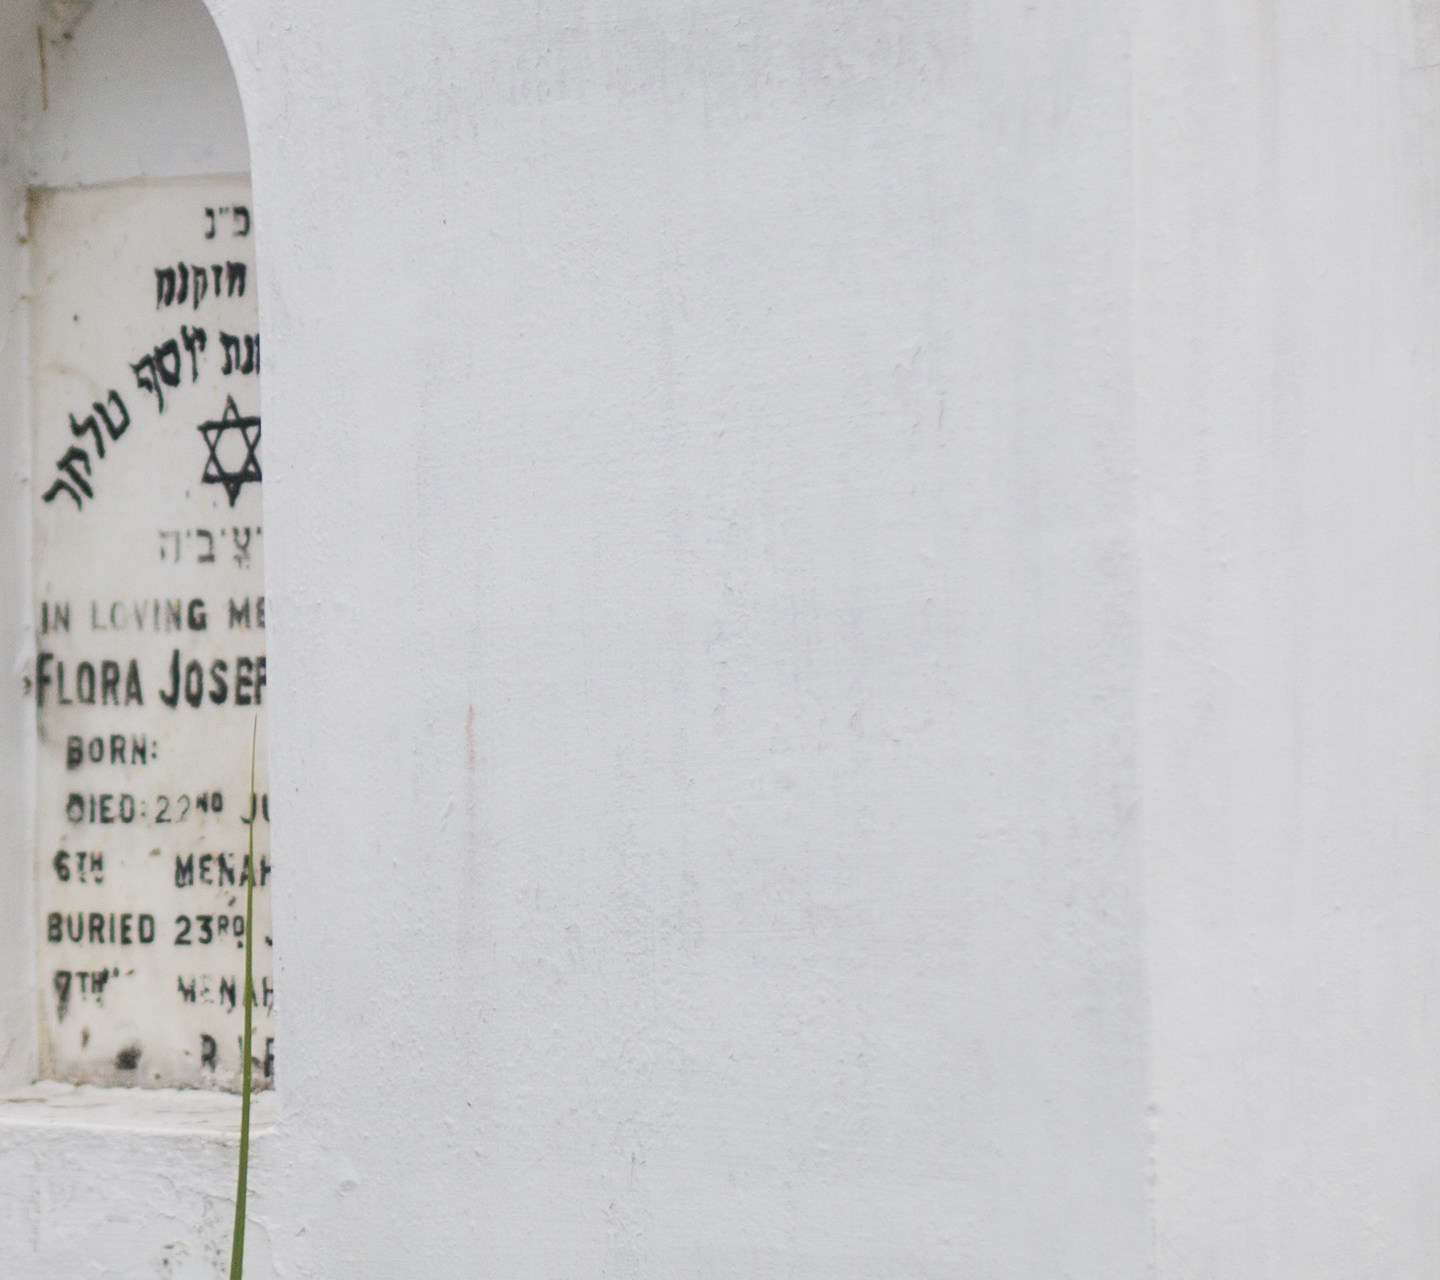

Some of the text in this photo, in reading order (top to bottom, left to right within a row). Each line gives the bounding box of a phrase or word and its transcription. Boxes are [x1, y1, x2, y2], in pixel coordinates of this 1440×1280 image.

[41, 600, 70, 634] IN
[91, 597, 207, 632] LOVING
[36, 651, 143, 707] FLORA
[66, 733, 157, 769] BORN:
[53, 849, 104, 884] 6TH
[47, 911, 155, 945] BURIED
[174, 914, 245, 947] 23RD
